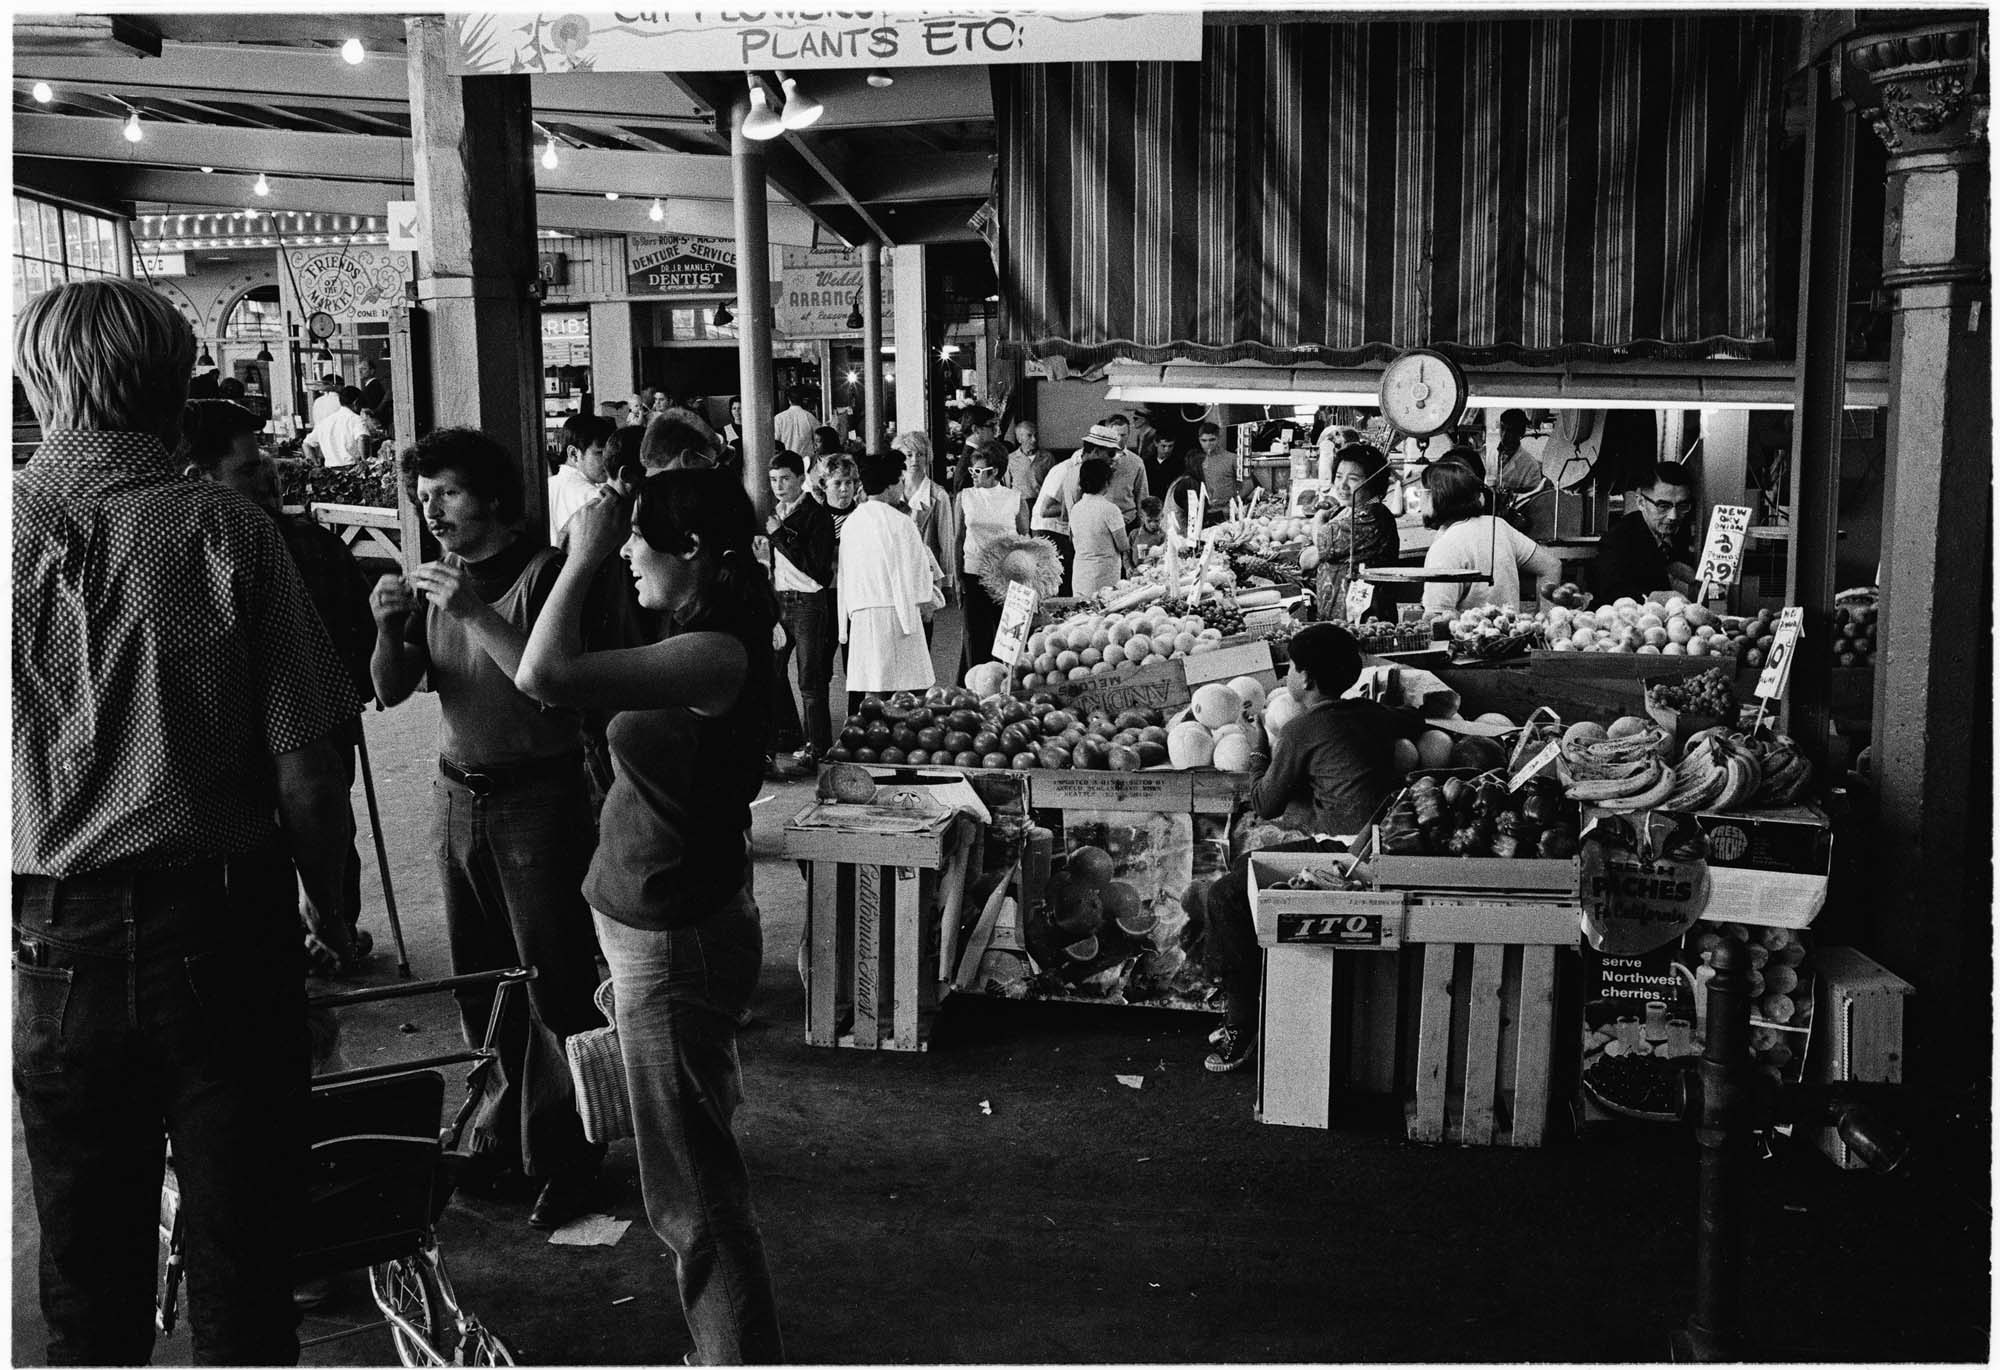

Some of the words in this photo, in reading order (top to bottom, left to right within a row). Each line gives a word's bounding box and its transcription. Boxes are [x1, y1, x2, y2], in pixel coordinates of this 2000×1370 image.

[737, 26, 899, 65] PLANTS
[632, 245, 680, 270] DENTURE
[689, 243, 736, 265] SERVICE
[305, 256, 361, 280] FRIENDS
[684, 263, 716, 272] MANLEY
[648, 272, 724, 286] DENTIST
[816, 271, 863, 287] Wedd
[307, 288, 353, 312] MARKET
[357, 310, 378, 318] COME
[1717, 506, 1748, 516] NEW
[1058, 676, 1121, 697] MELOS
[1295, 916, 1367, 937] ITO
[1602, 958, 1642, 967] serve
[1602, 970, 1682, 986] Northwest
[1601, 986, 1677, 1000] cherries...
